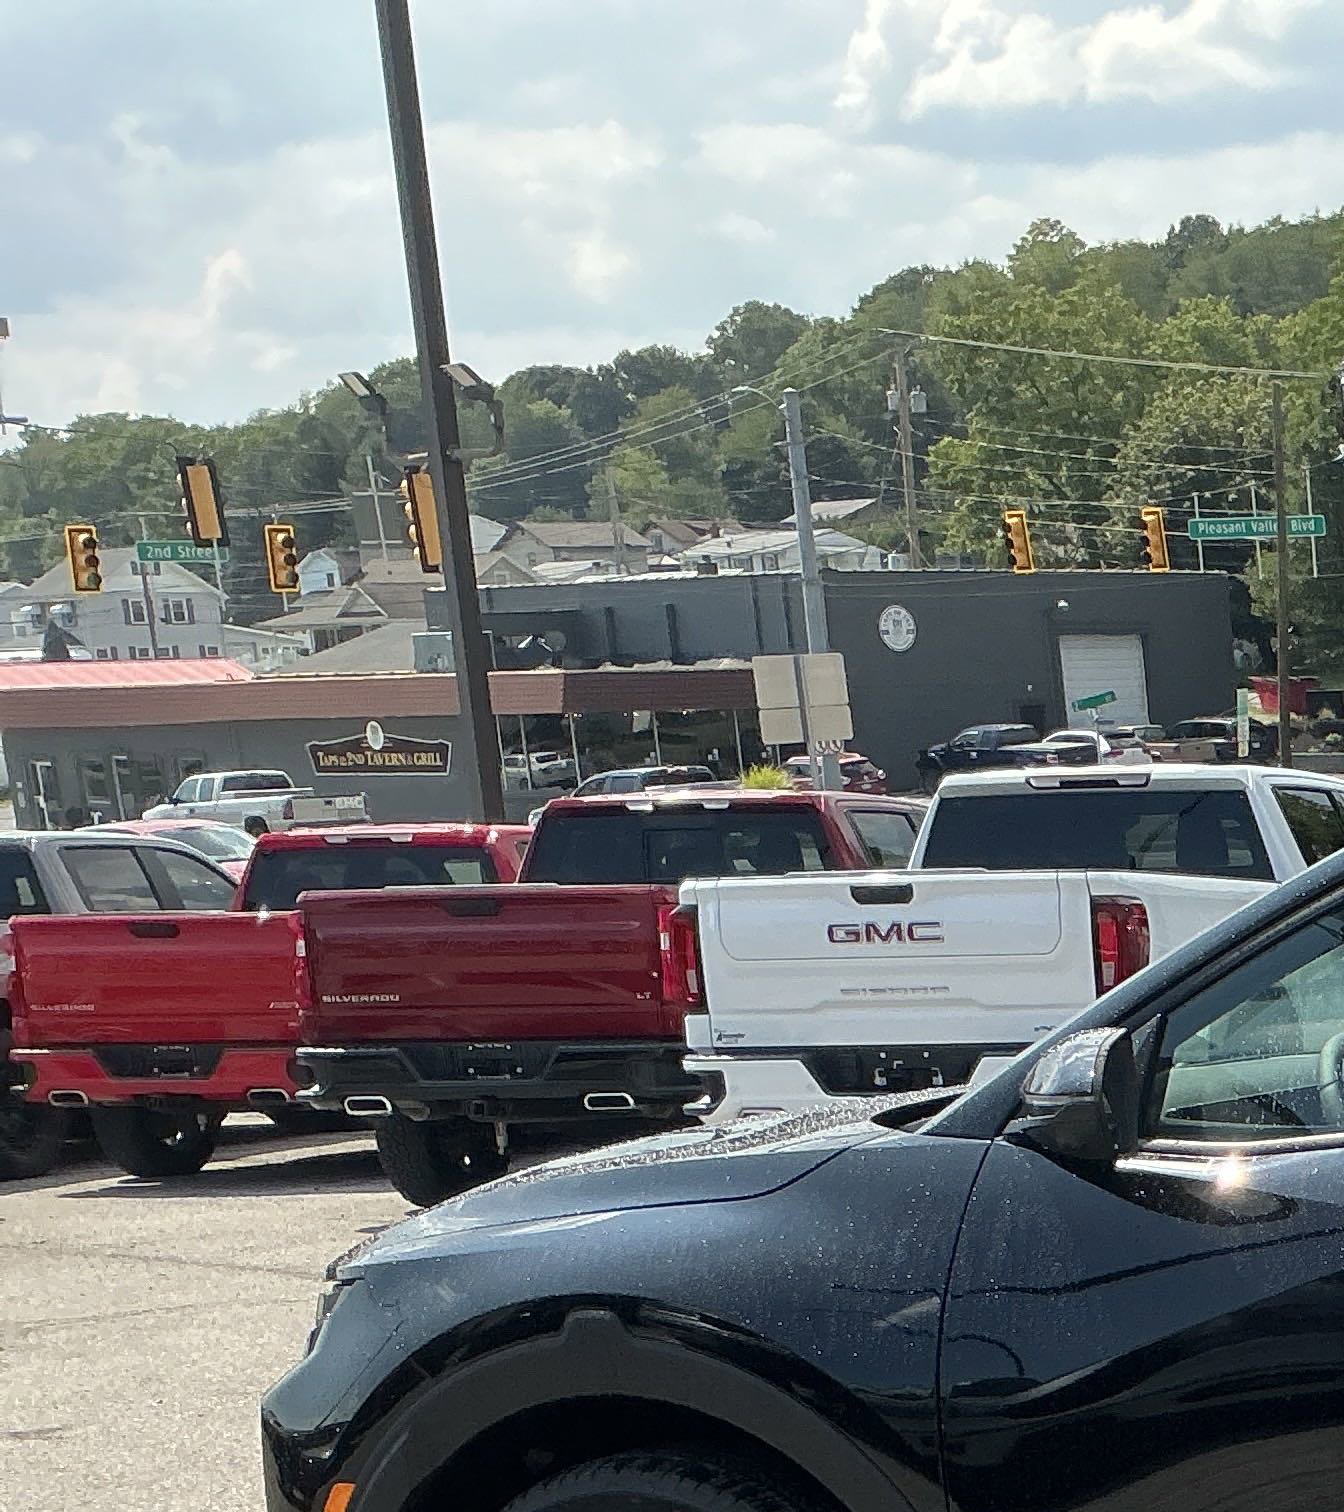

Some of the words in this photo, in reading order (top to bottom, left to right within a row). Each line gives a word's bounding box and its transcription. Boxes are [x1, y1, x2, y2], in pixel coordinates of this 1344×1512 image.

[1197, 521, 1247, 535] Pleasant
[1250, 520, 1279, 533] Valle
[1290, 518, 1315, 532] Blvd
[146, 545, 172, 559] 2nd
[364, 751, 407, 766] TAVERN
[413, 752, 443, 766] GRILL
[827, 920, 945, 944] GMC
[321, 994, 401, 1003] SILVERADO
